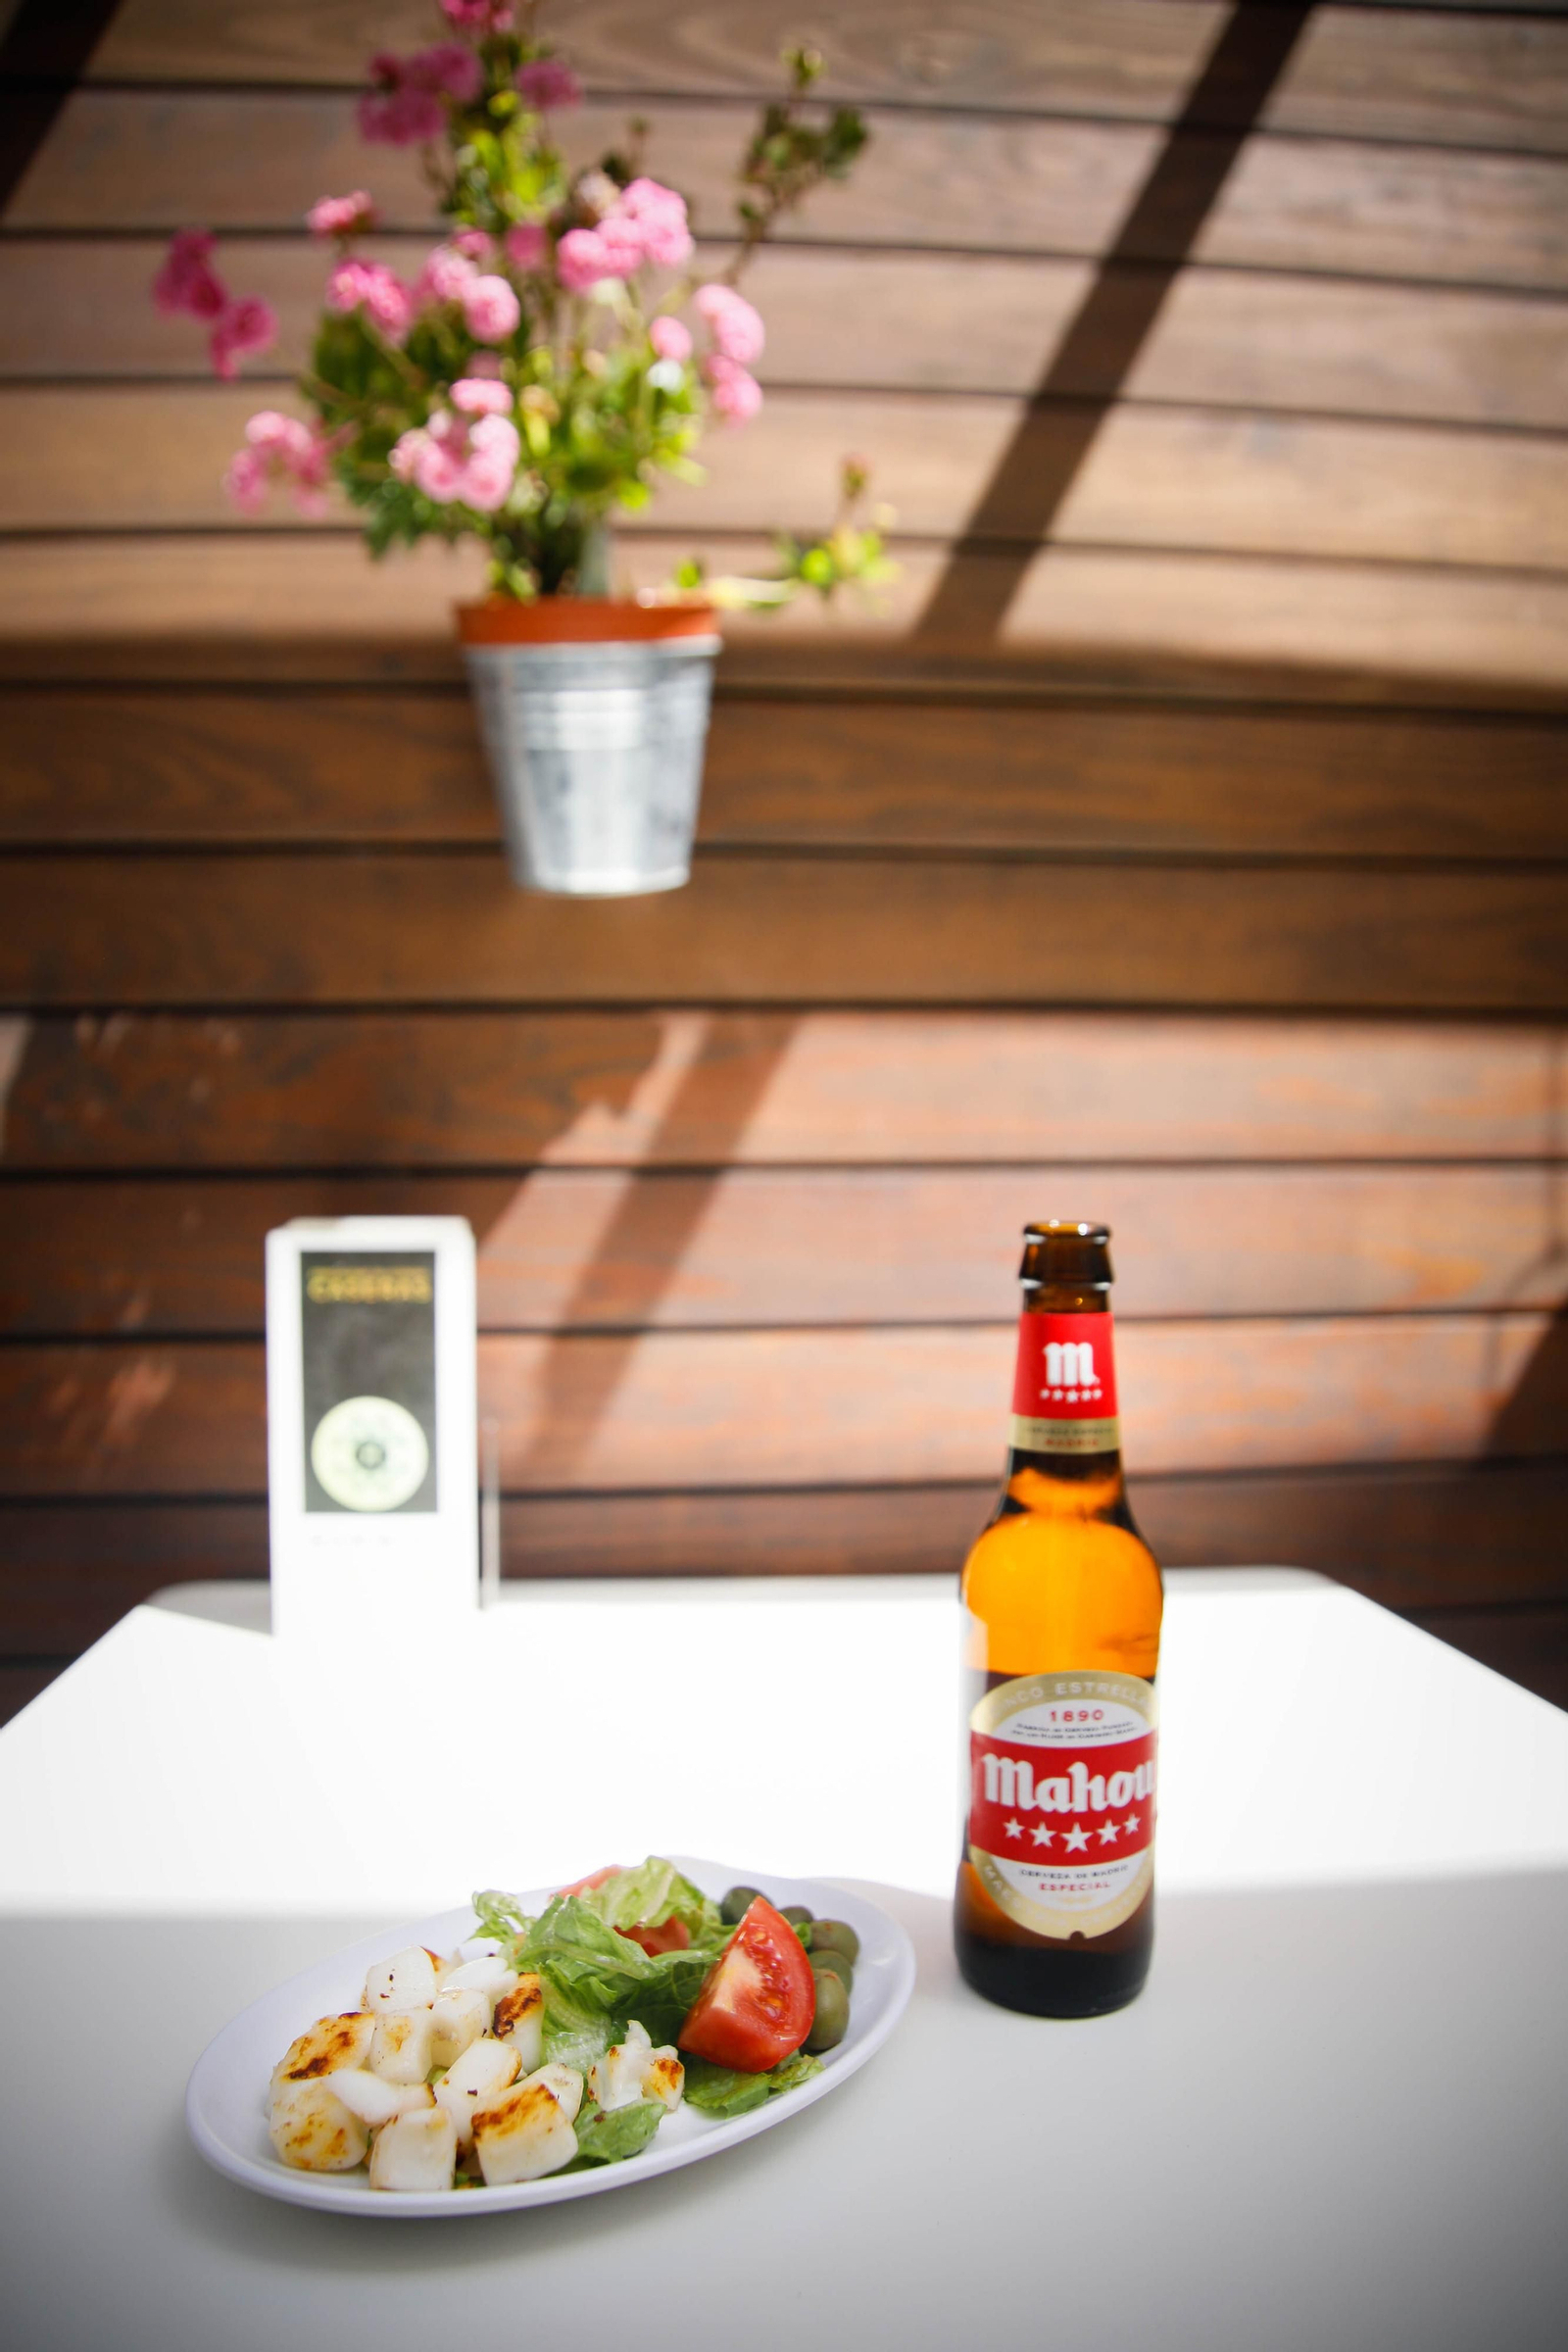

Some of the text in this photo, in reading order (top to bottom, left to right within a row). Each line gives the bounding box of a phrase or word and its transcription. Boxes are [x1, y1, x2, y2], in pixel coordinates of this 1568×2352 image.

[1049, 1709, 1105, 1723] 1890
[981, 1752, 1154, 1813] Mahou
[1040, 1881, 1111, 1892] ESPECIAL
